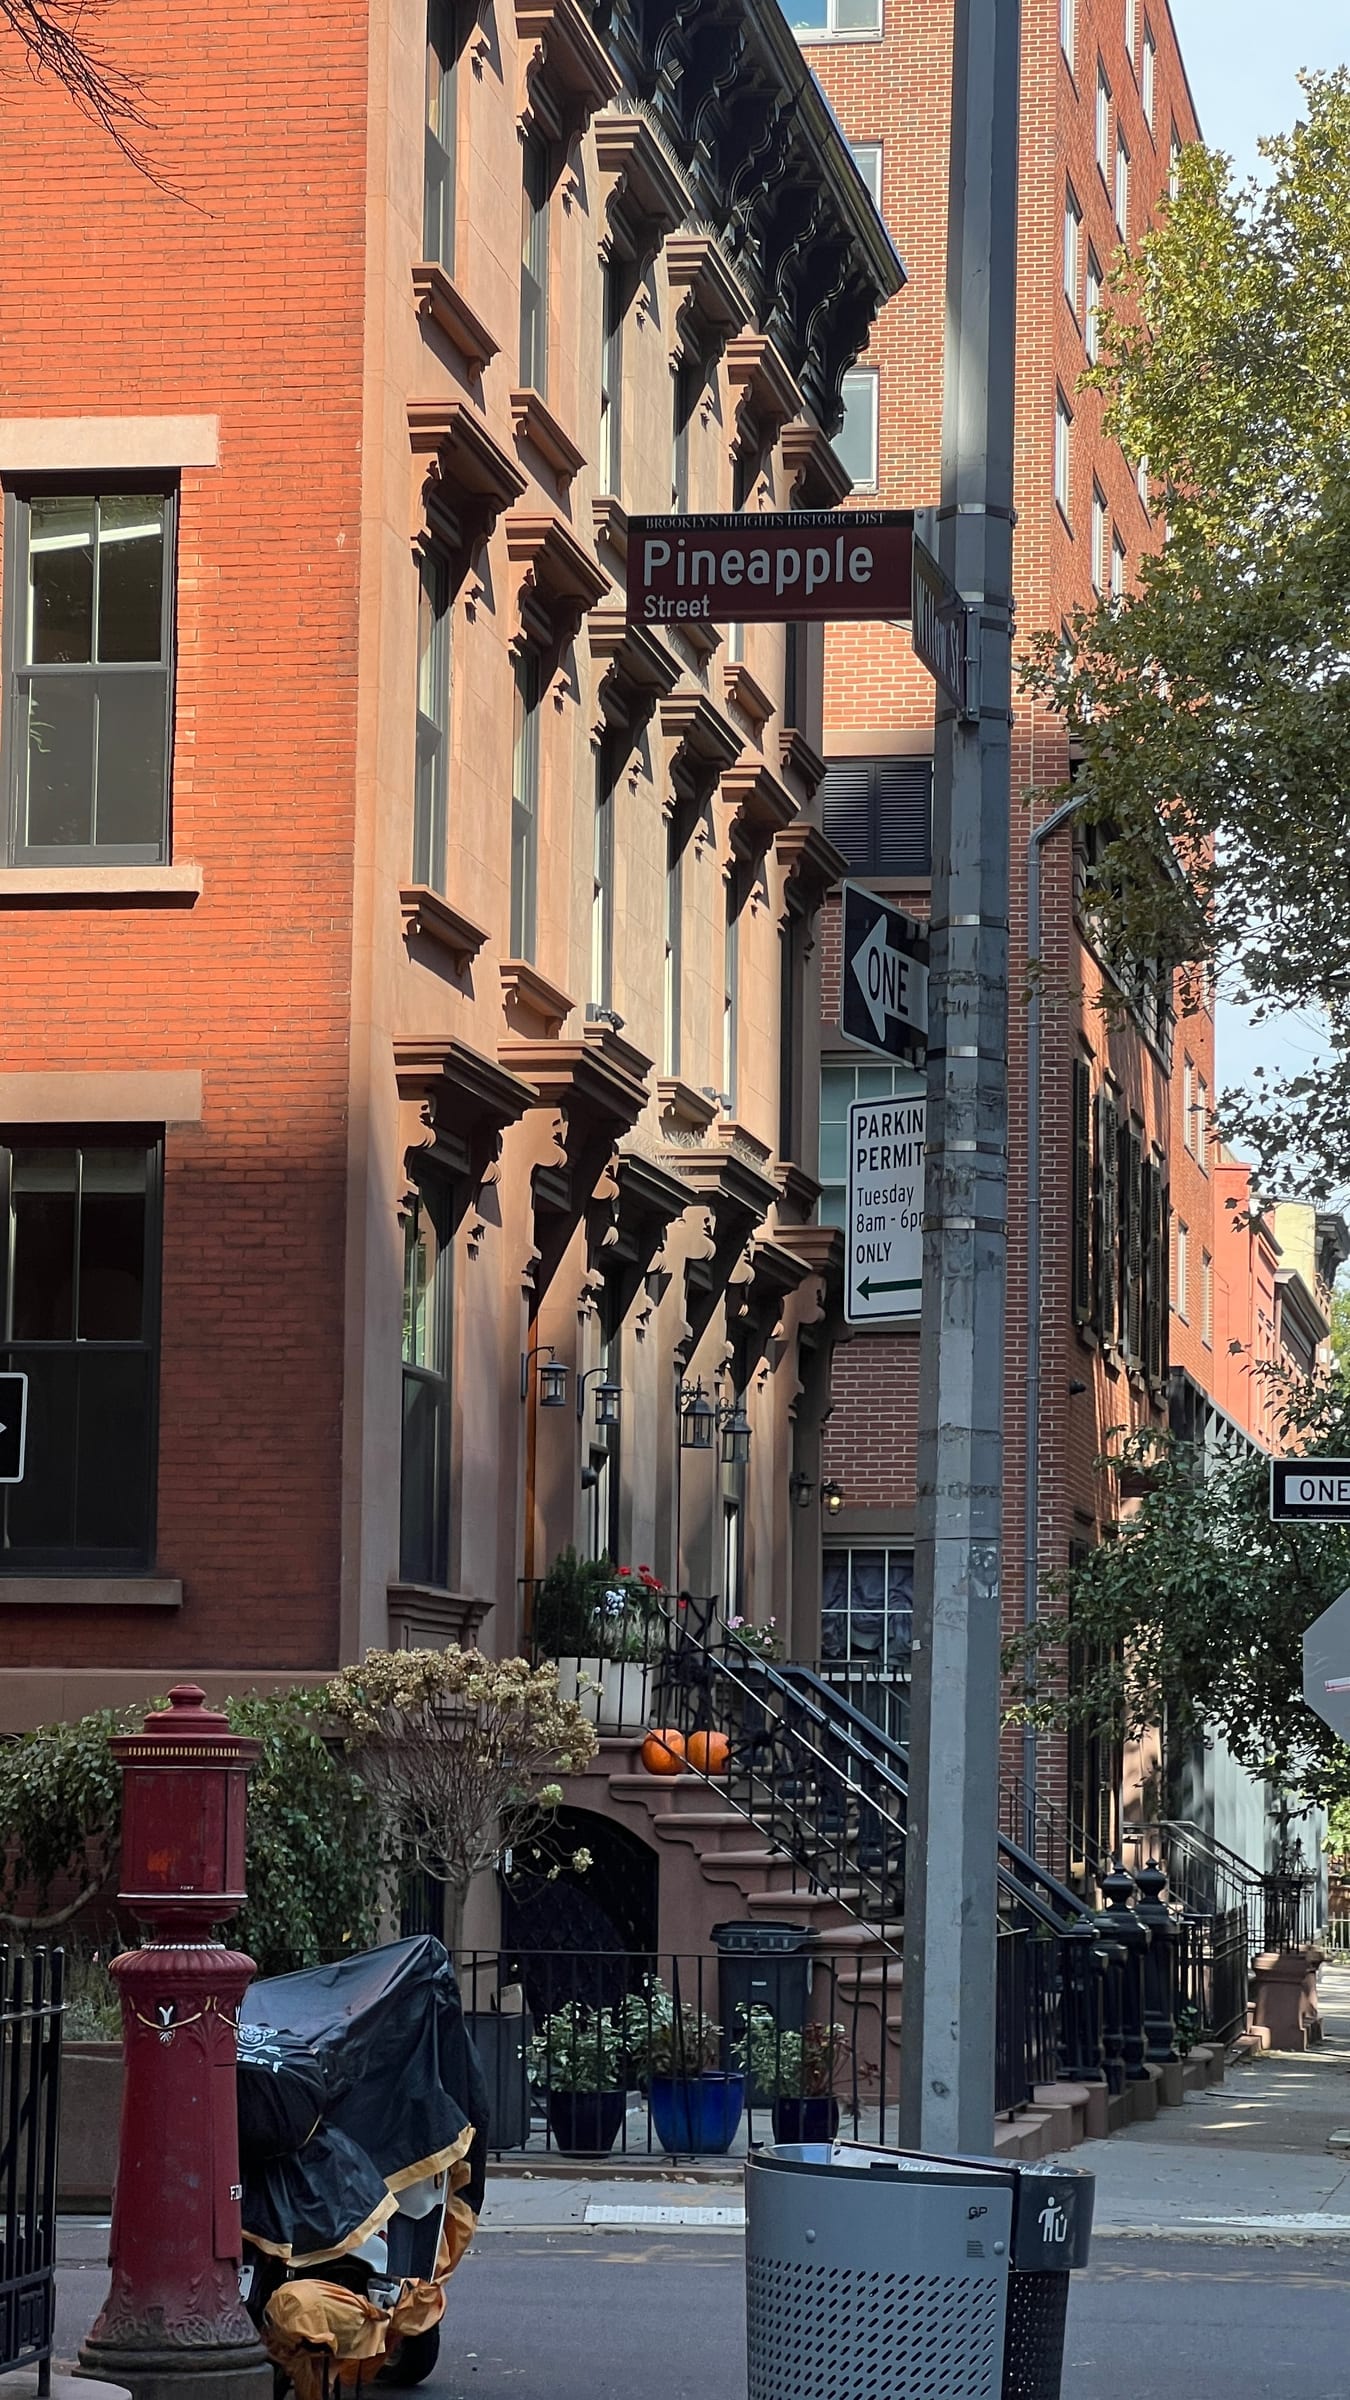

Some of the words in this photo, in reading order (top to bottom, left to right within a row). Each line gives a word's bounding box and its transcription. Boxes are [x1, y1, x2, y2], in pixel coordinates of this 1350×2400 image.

[646, 516, 719, 529] BROOKLYN
[724, 514, 784, 528] HEIGHTS
[787, 513, 851, 526] HISTORIC
[855, 511, 885, 525] DIST
[643, 535, 874, 596] Pineapple
[643, 594, 710, 618] Street
[916, 571, 947, 676] Willow
[950, 619, 960, 695] St
[867, 945, 909, 1017] ONE
[857, 1107, 924, 1140] PARKIN
[857, 1184, 914, 1207] Tuesday
[856, 1213, 886, 1233] 8am
[900, 1209, 924, 1232] 6p
[856, 1241, 892, 1265] ONLY
[1300, 1479, 1350, 1502] ONE
